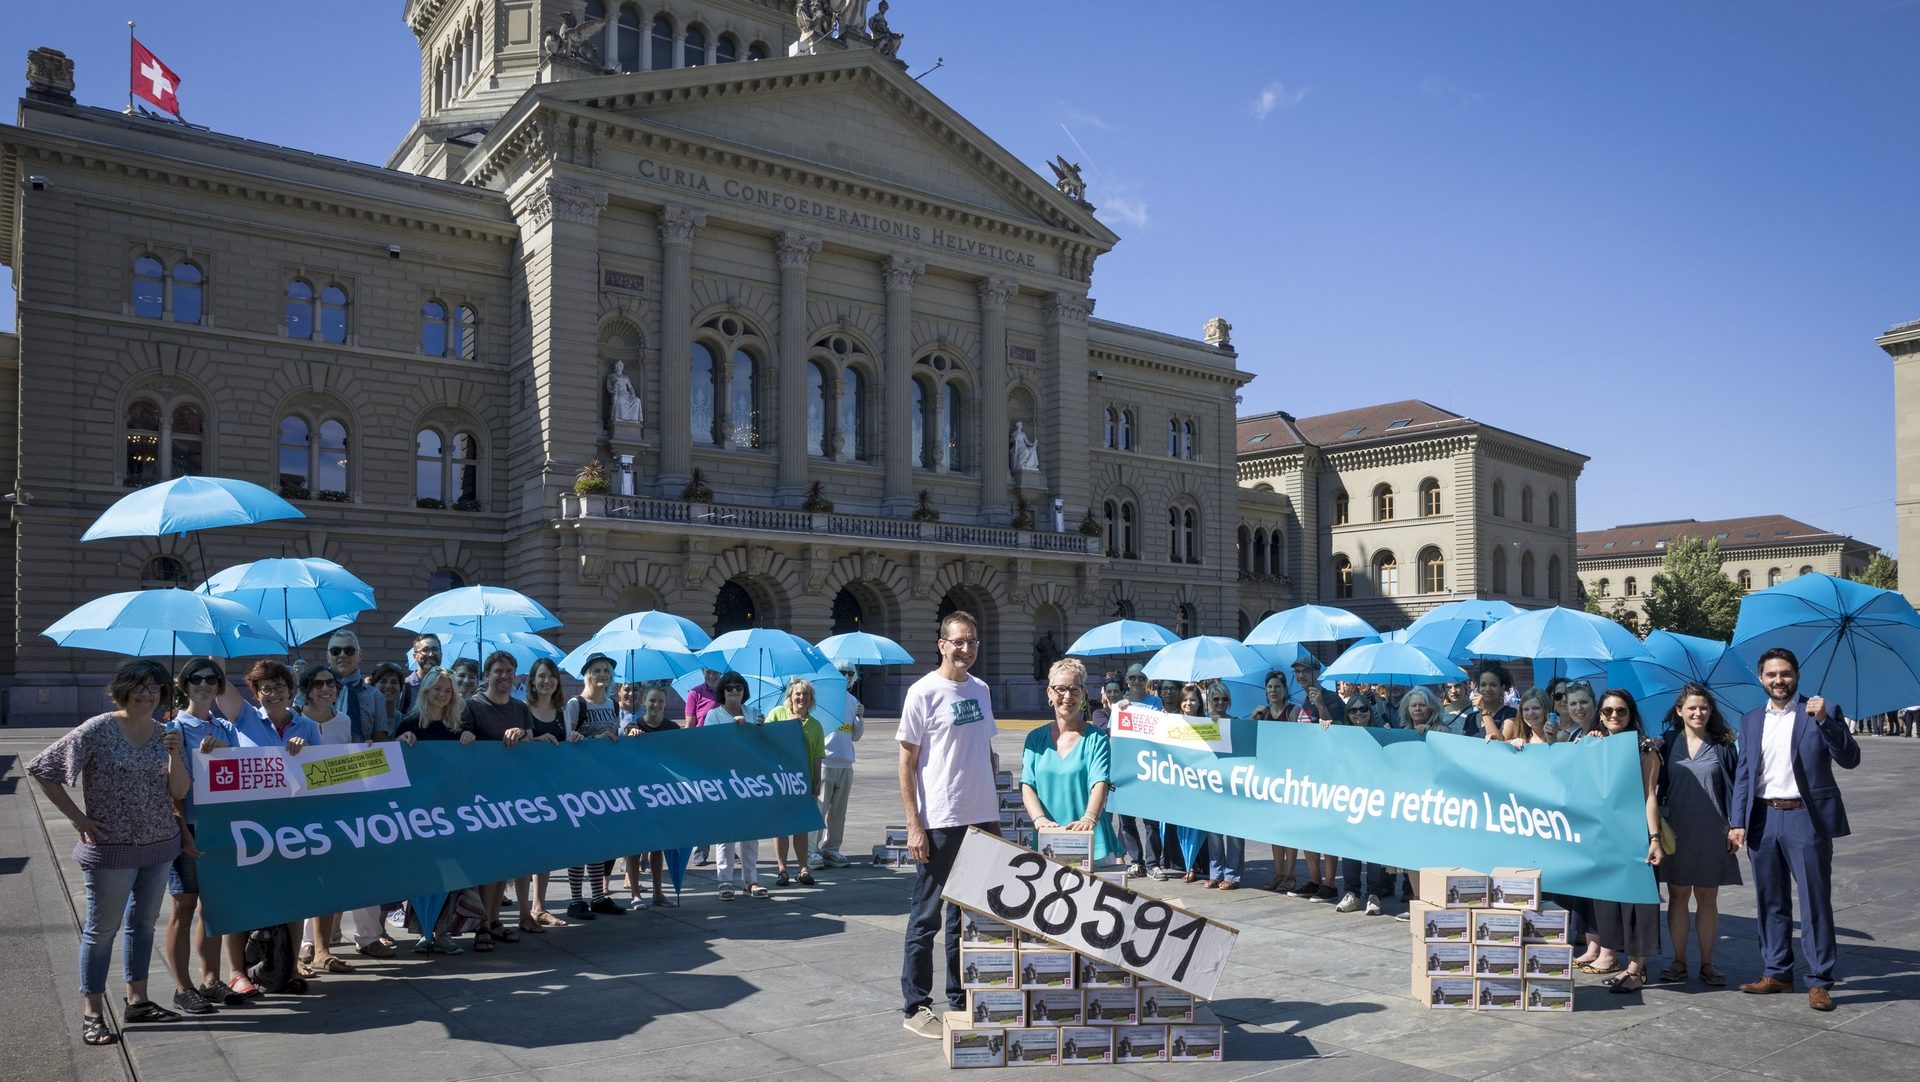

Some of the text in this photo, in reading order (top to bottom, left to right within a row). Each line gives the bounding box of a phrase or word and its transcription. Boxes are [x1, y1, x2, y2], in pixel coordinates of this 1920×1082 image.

[638, 159, 1036, 268] CURIA CONFOEDERATIONIS HELVETICAE
[1133, 713, 1160, 726] HEKS
[1133, 722, 1155, 736] EPER
[241, 757, 285, 773] HEKS
[241, 774, 287, 790] EPER
[230, 764, 808, 867] Des voies sûres pour sauver des vies
[1136, 750, 1581, 843] Sichere Fluchtwege retten Leben.
[987, 852, 1207, 982] 38'591
